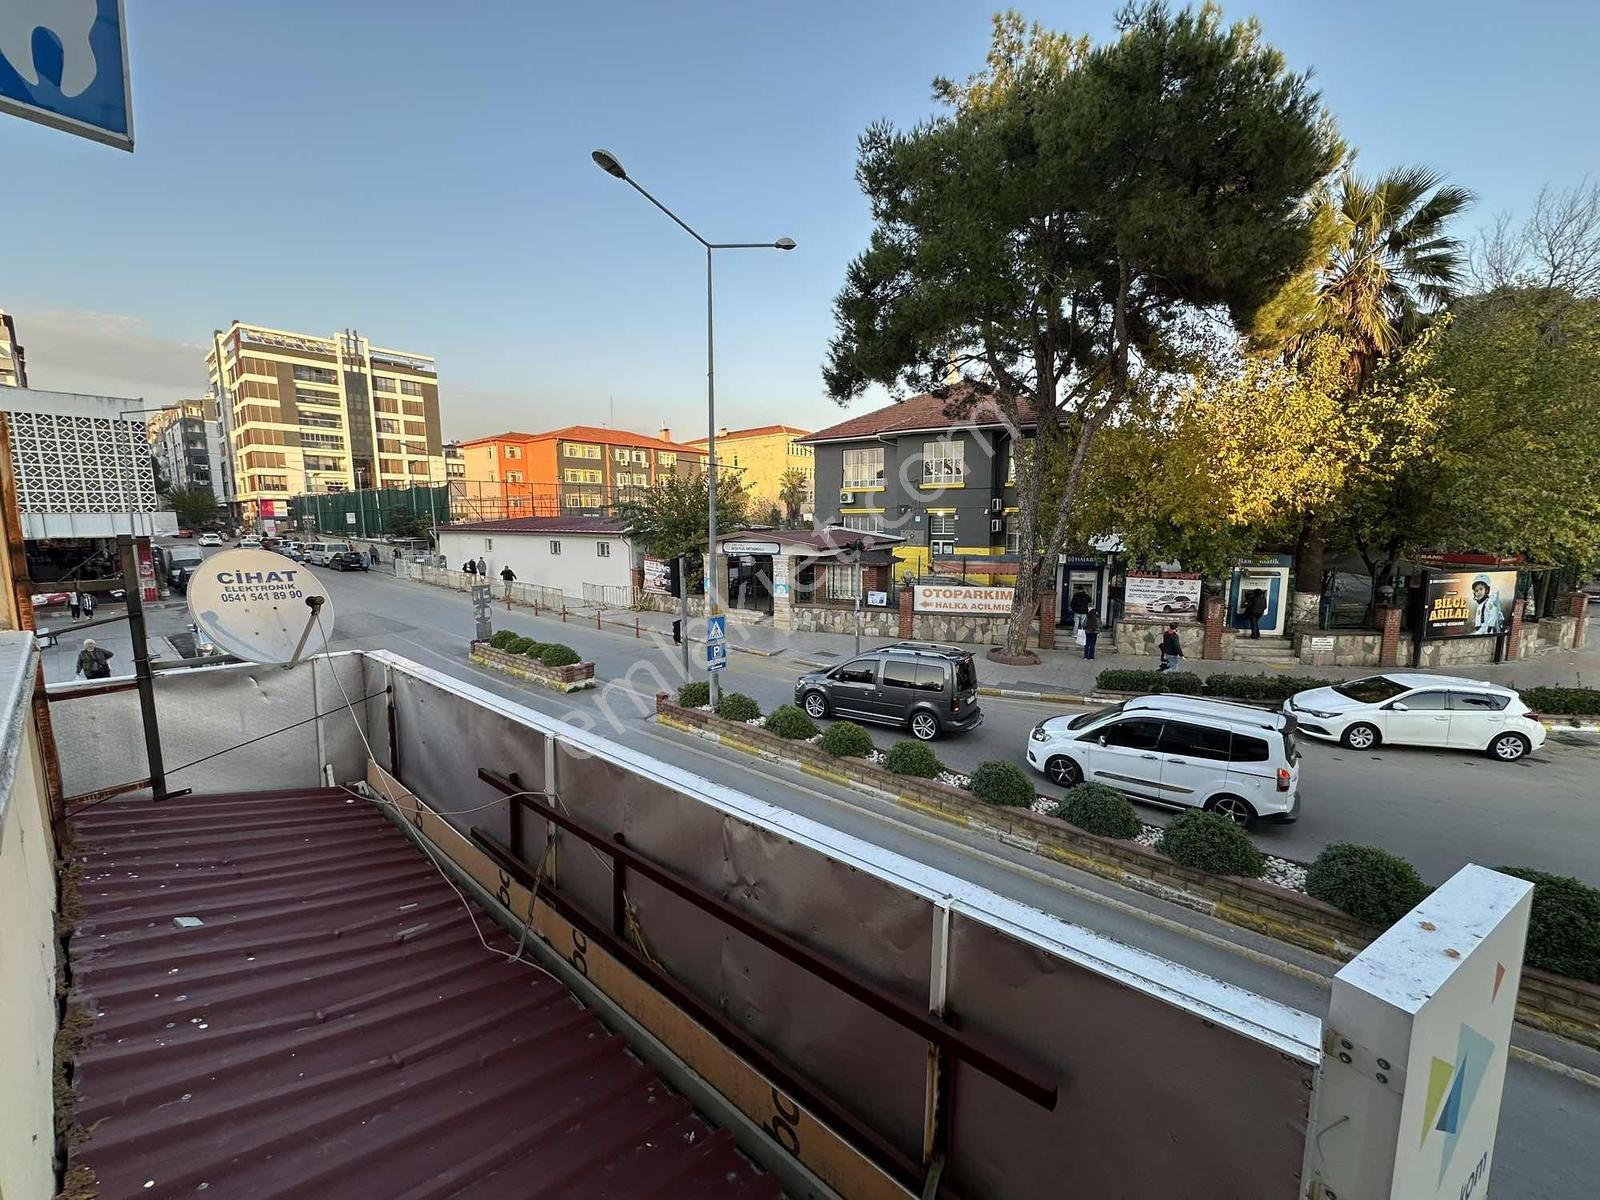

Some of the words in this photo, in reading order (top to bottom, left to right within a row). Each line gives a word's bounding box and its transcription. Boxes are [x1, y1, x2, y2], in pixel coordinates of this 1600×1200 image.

[217, 569, 297, 584] CİHAT
[221, 593, 247, 602] 0541
[250, 592, 270, 601] 541
[273, 591, 287, 600] 89
[289, 590, 303, 598] 90
[922, 588, 1013, 601] OTOPARKIM
[935, 602, 968, 610] HALKA
[1429, 608, 1470, 621] ARILAR
[713, 646, 720, 657] P
